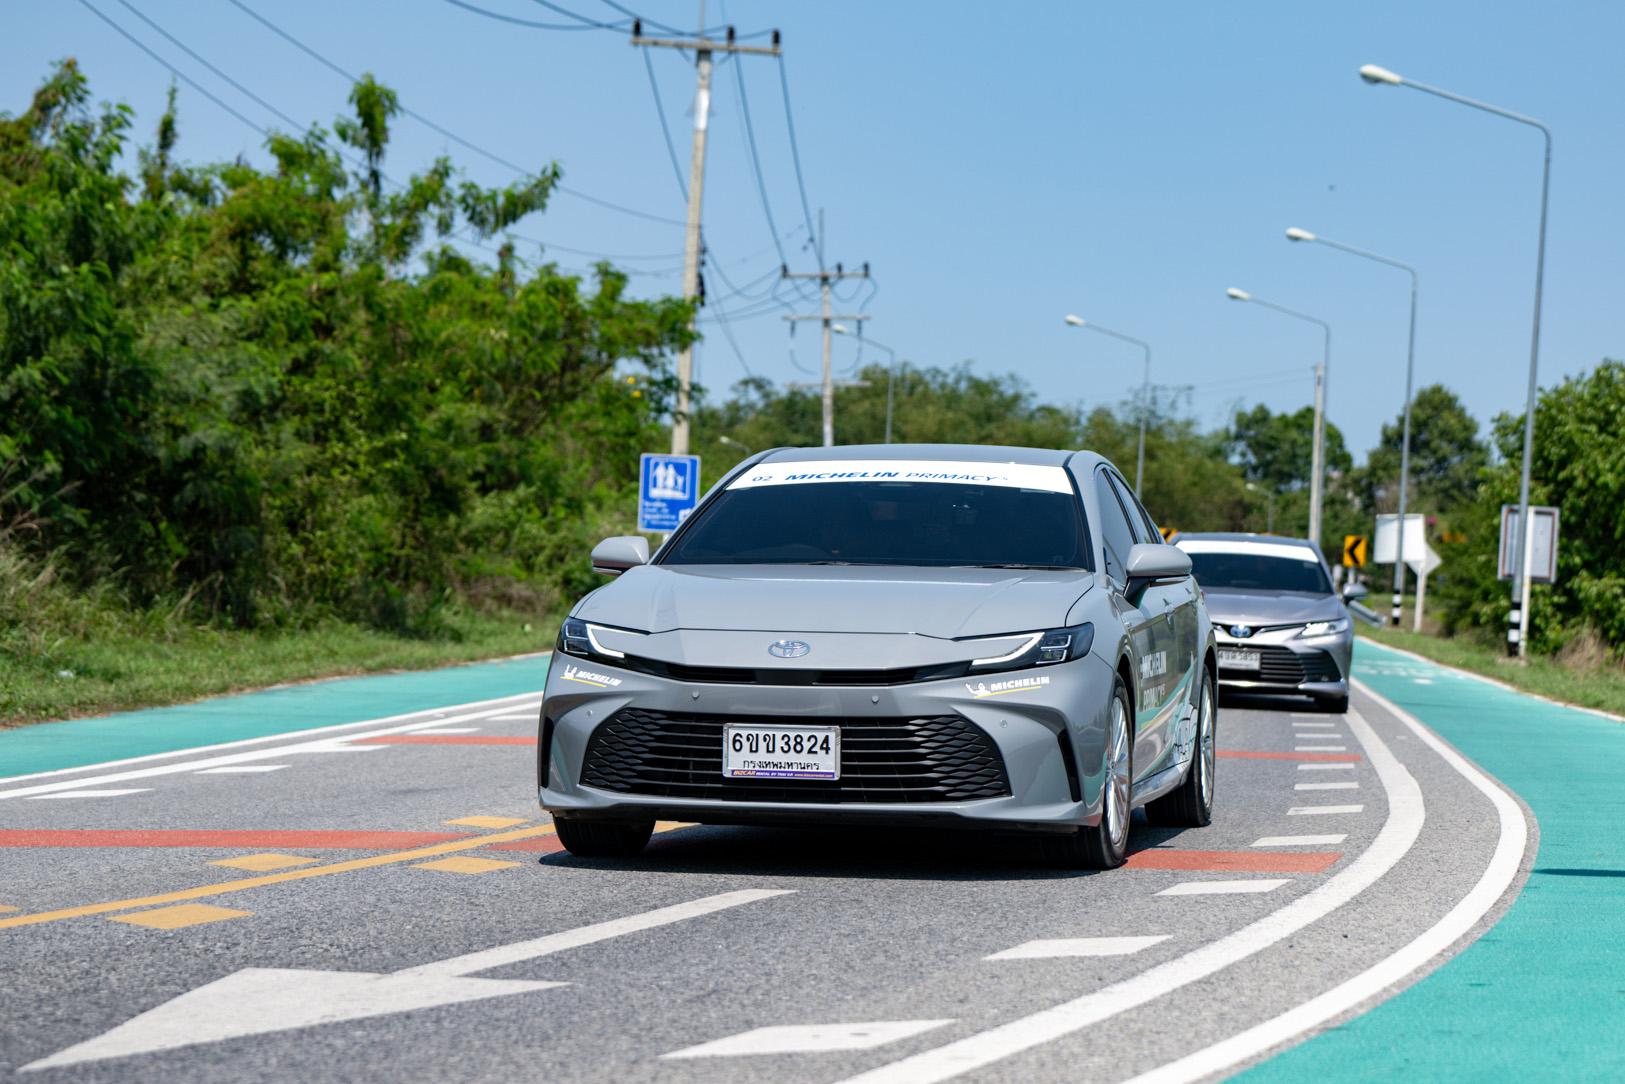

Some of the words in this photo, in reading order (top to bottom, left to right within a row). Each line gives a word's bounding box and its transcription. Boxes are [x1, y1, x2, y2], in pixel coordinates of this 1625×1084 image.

[785, 471, 900, 481] MICHELIN
[905, 472, 998, 482] PRIMACY
[1141, 650, 1167, 680] MICHELIN
[575, 670, 622, 687] MICHELIN
[990, 676, 1050, 692] MICHELIN
[780, 733, 831, 755] 3824
[743, 760, 820, 770] กรงเทพมหานคร
